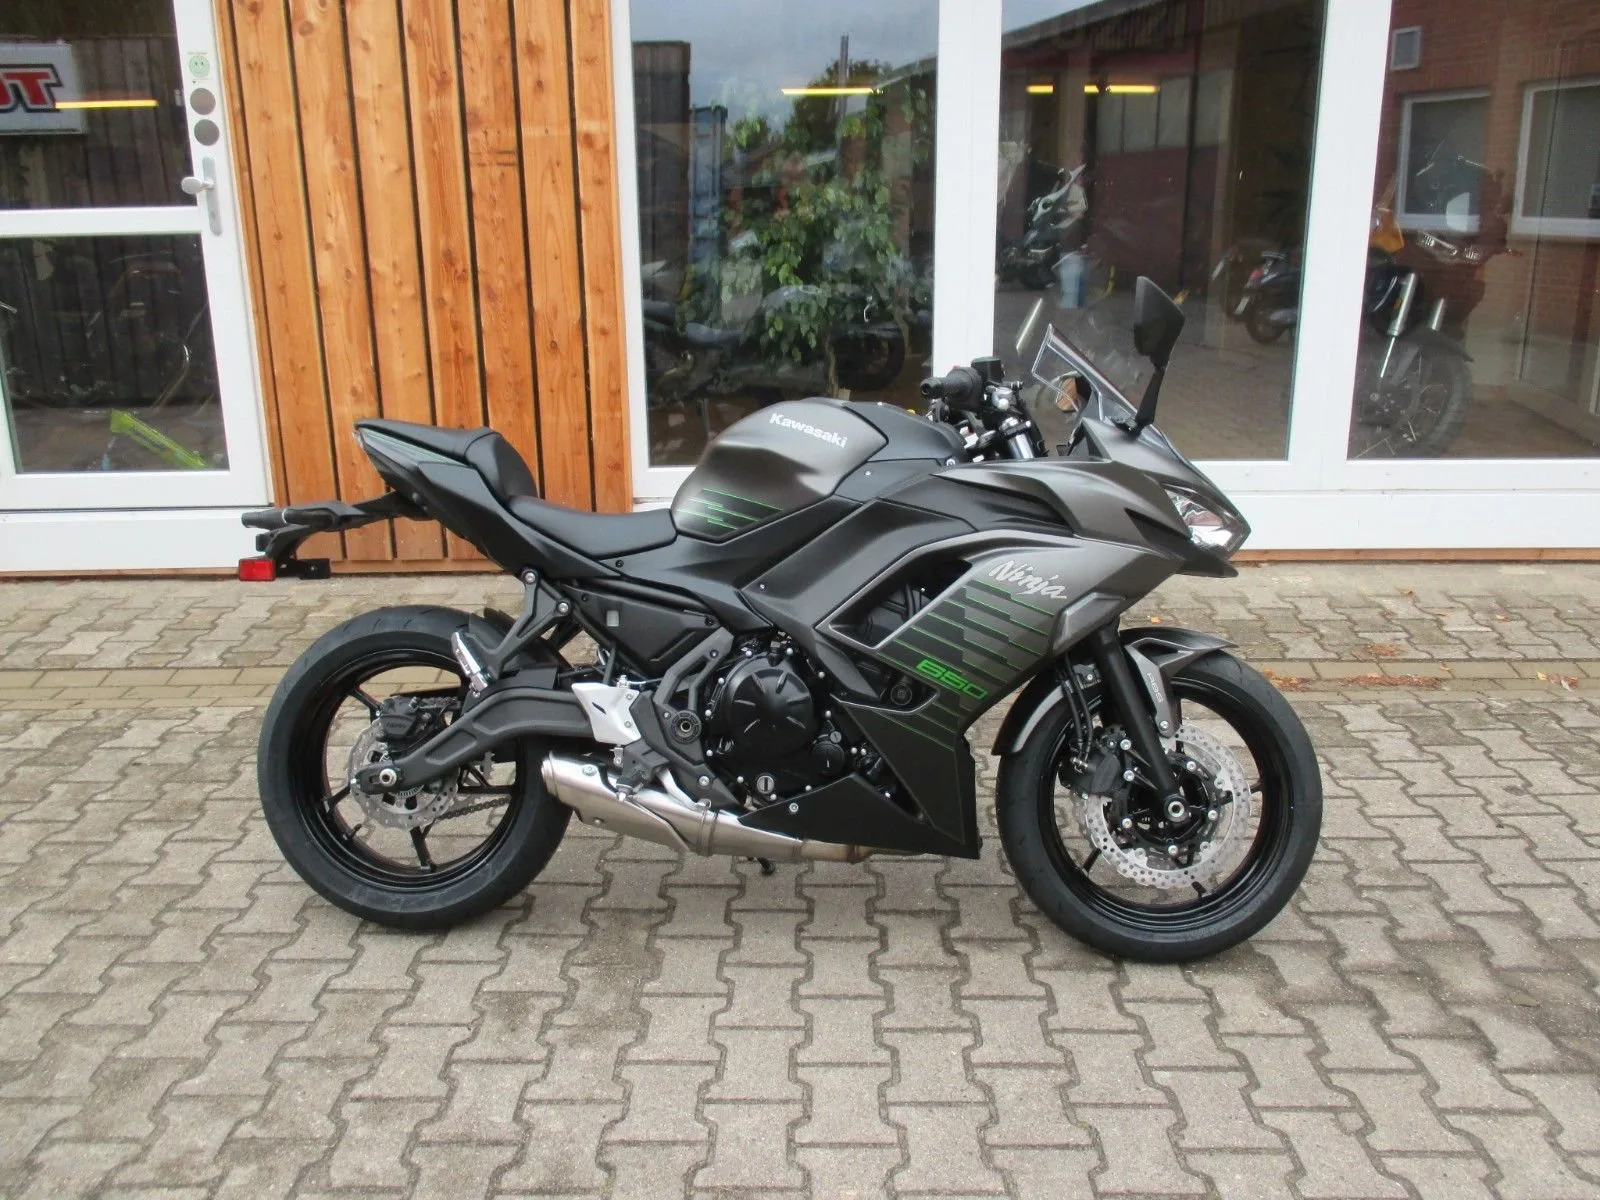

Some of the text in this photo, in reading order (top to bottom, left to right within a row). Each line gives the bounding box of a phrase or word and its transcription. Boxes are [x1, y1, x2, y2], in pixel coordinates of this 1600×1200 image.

[769, 413, 848, 448] Kawasaki
[988, 560, 1067, 600] Ninja
[916, 659, 989, 700] 650
[1146, 672, 1164, 703] ABS
